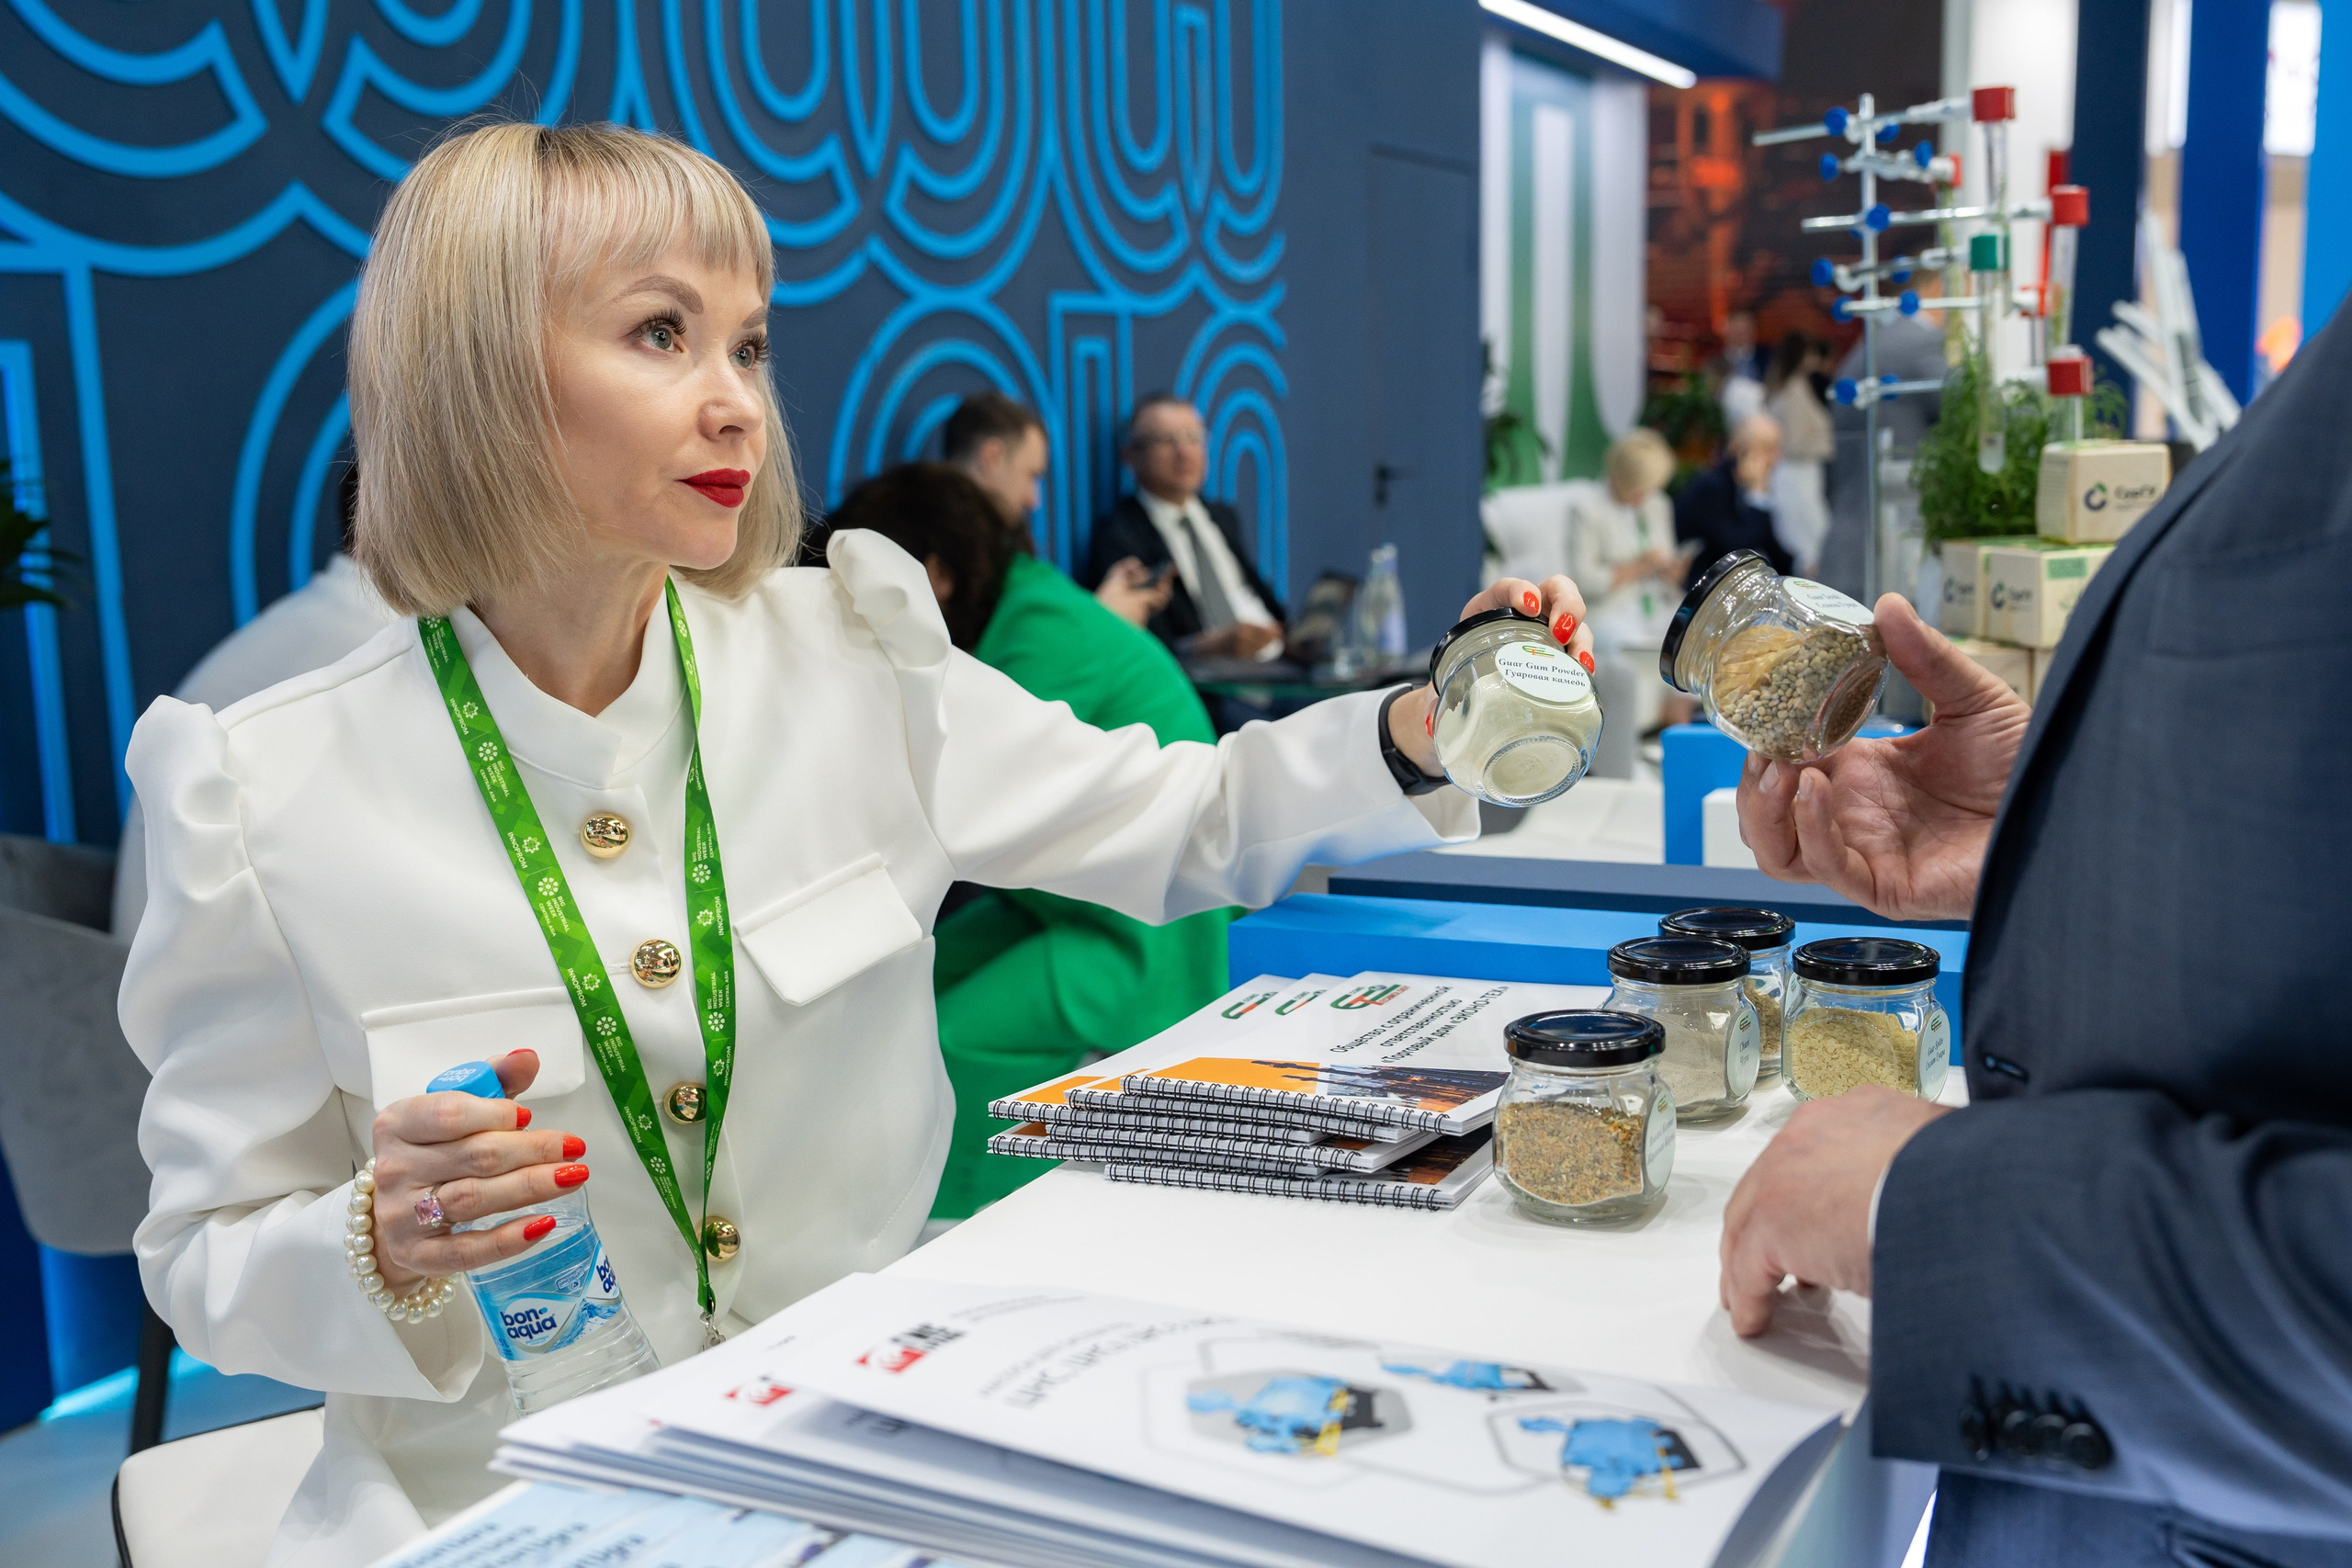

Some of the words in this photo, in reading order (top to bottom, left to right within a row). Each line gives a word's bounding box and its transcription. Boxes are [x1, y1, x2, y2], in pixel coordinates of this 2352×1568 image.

[426, 636, 435, 658] CENTRAL
[436, 630, 449, 663] INDUSTRIAL
[1498, 658, 1523, 668] Guar
[1525, 661, 1548, 671] Gum
[1551, 665, 1586, 678] Powder
[1505, 669, 1549, 682] Гуаровая
[1552, 677, 1586, 687] камедь
[450, 697, 469, 735] INNOPROM
[486, 765, 497, 784] WEEK
[492, 762, 511, 797] INDUSTRIAL
[497, 760, 505, 772] BIG
[480, 769, 492, 791] CENTRAL
[489, 790, 497, 803] ASIA
[507, 831, 528, 869] INNOPROM
[546, 900, 558, 918] WEEK
[552, 897, 571, 932] INDUSTRIAL
[558, 896, 566, 907] BIG
[715, 896, 724, 936] INNOPROM
[538, 903, 551, 925] CENTRAL
[548, 925, 557, 937] ASIA
[567, 967, 587, 1008] INNOPROM
[1329, 1028, 1386, 1053] Общество
[1387, 986, 1453, 1025] ограниченной
[1380, 998, 1462, 1047] ответственностью
[1381, 1036, 1438, 1064] «Торговый
[1431, 1024, 1458, 1041] дом
[1450, 986, 1510, 1024] «ЭКОНО-ТЕХ»
[604, 1040, 615, 1059] WEEK
[610, 1038, 627, 1073] INDUSTRIAL
[615, 1036, 624, 1047] BIG
[596, 1043, 608, 1065] CENTRAL
[605, 1065, 614, 1077] ASIA
[624, 1106, 642, 1144] INNOPROM
[506, 1315, 558, 1339] aqua
